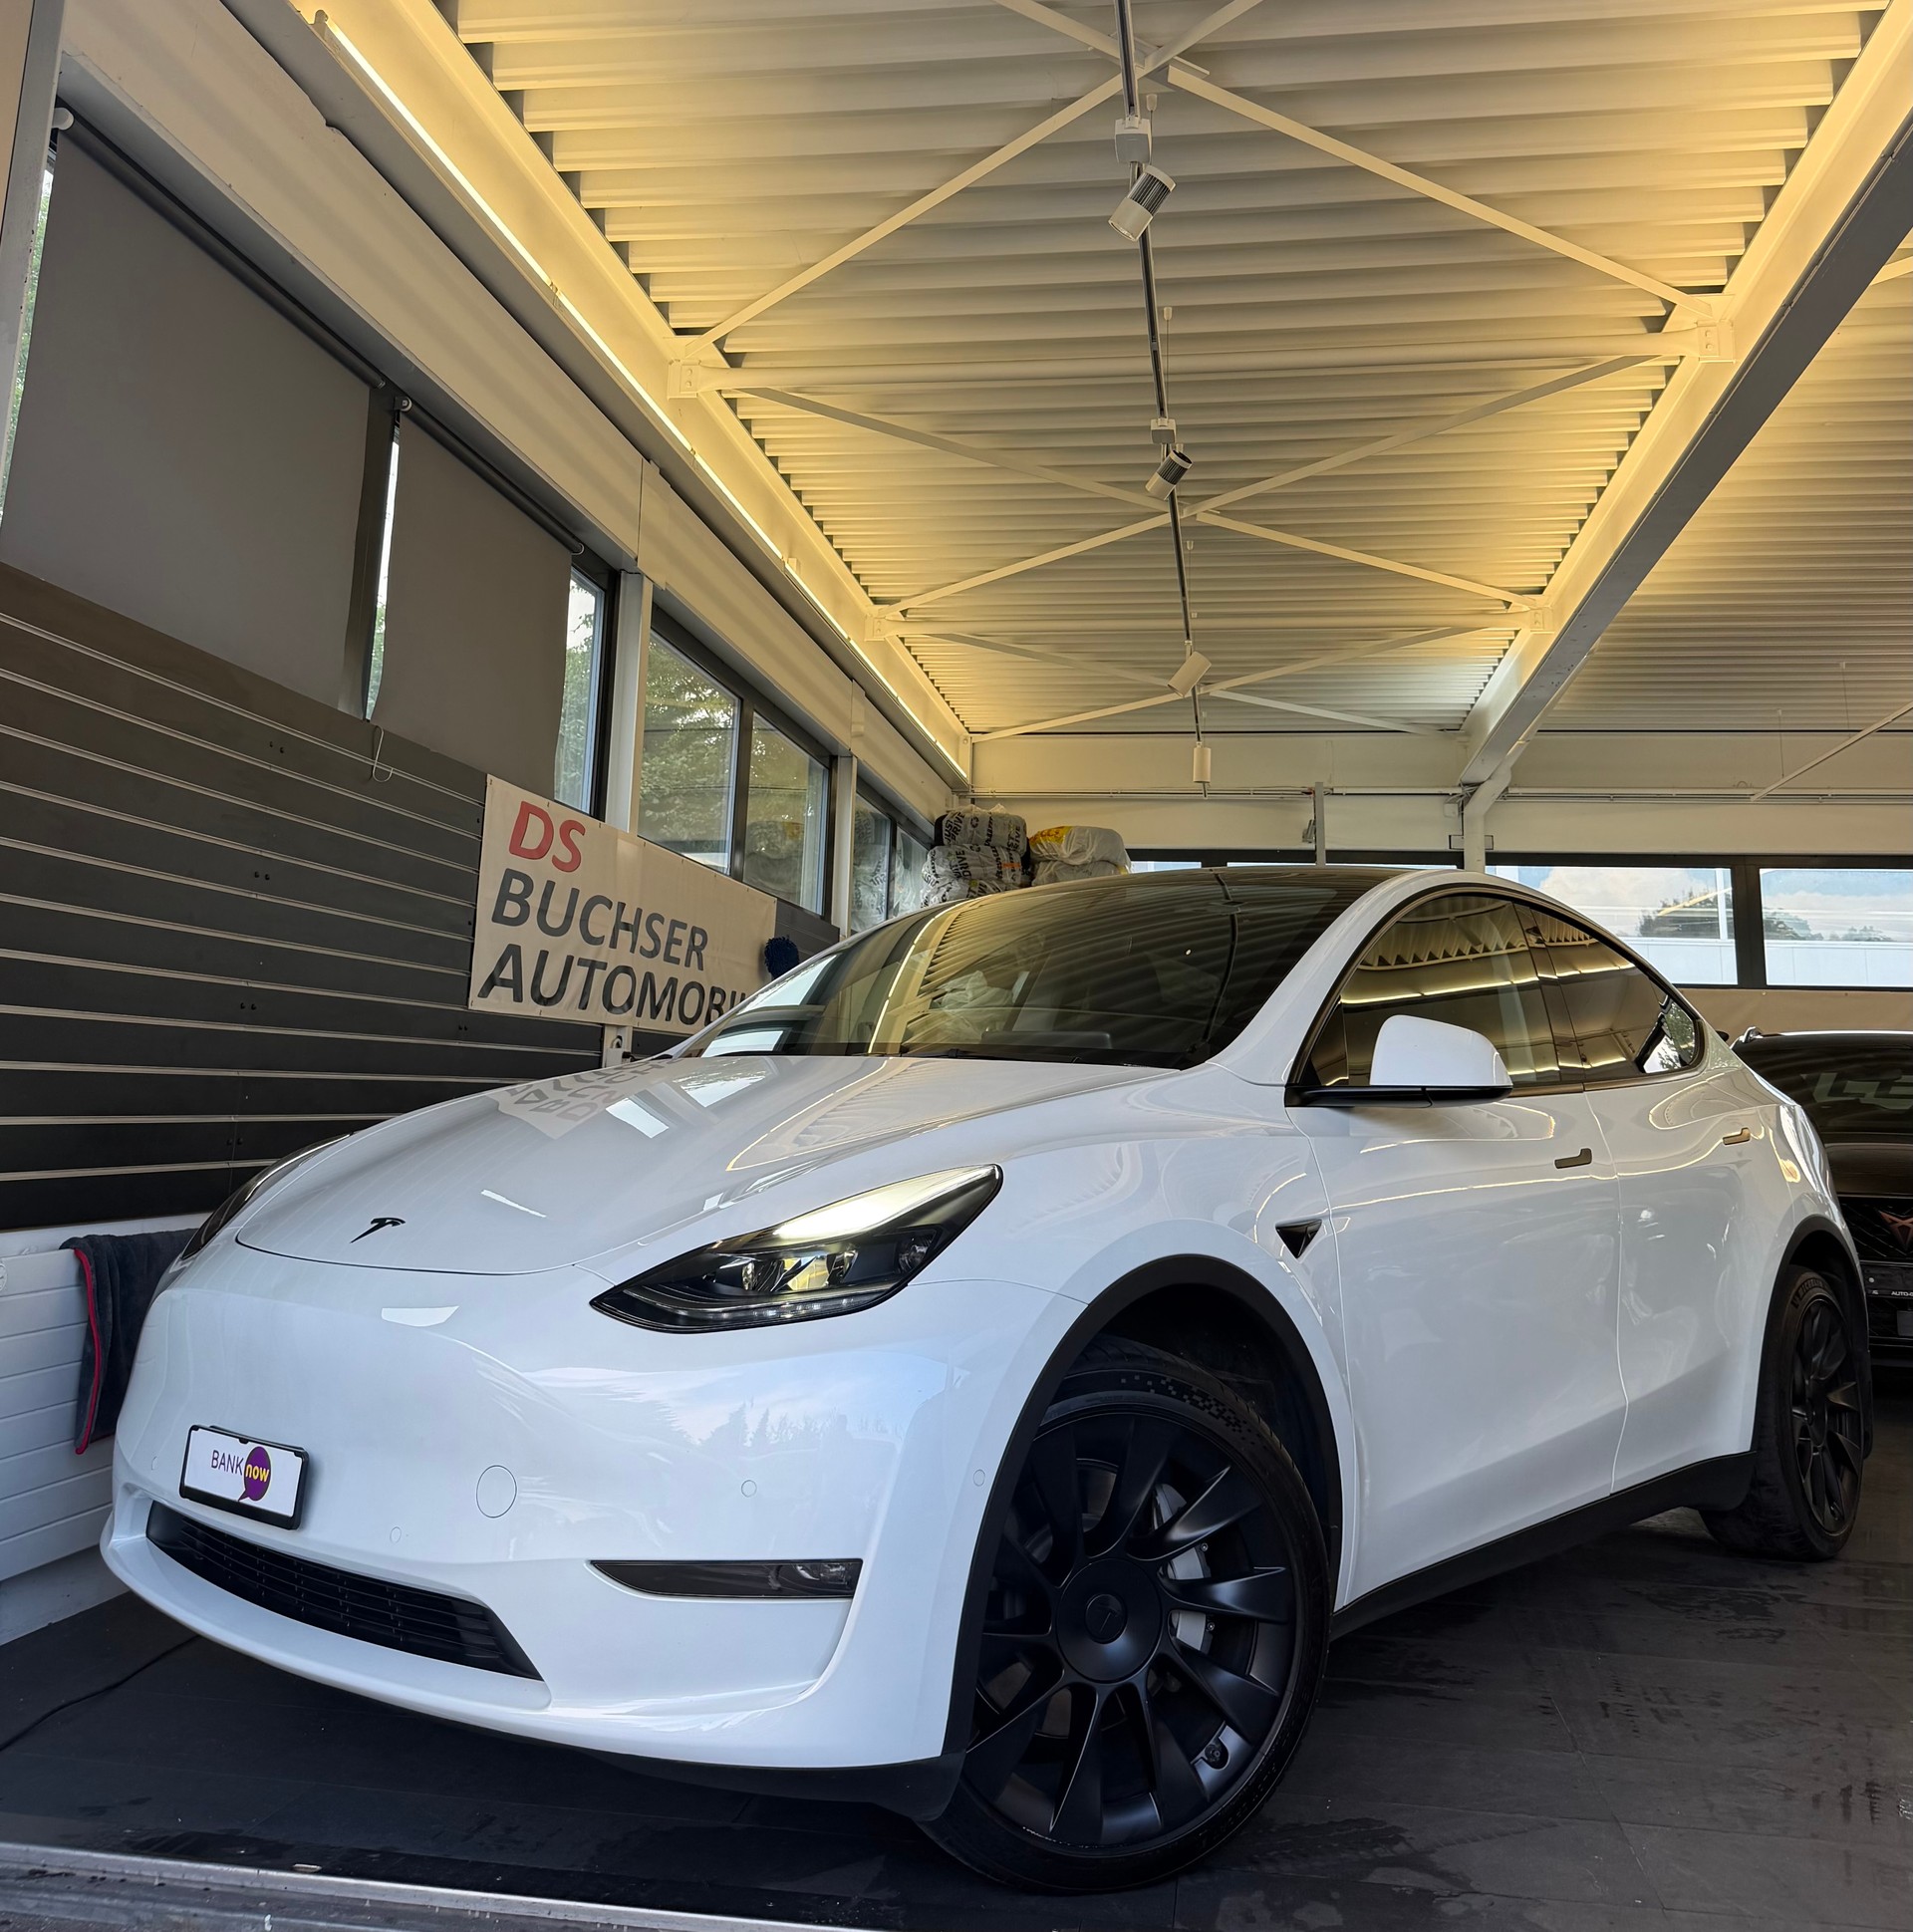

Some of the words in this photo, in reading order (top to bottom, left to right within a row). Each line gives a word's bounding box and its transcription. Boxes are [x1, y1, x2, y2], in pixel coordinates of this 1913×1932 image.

[509, 801, 586, 872] DS
[491, 868, 708, 971] BUCHSER
[478, 944, 746, 1027] AUTOMOBI
[211, 1450, 244, 1476] BANK
[245, 1464, 269, 1483] now
